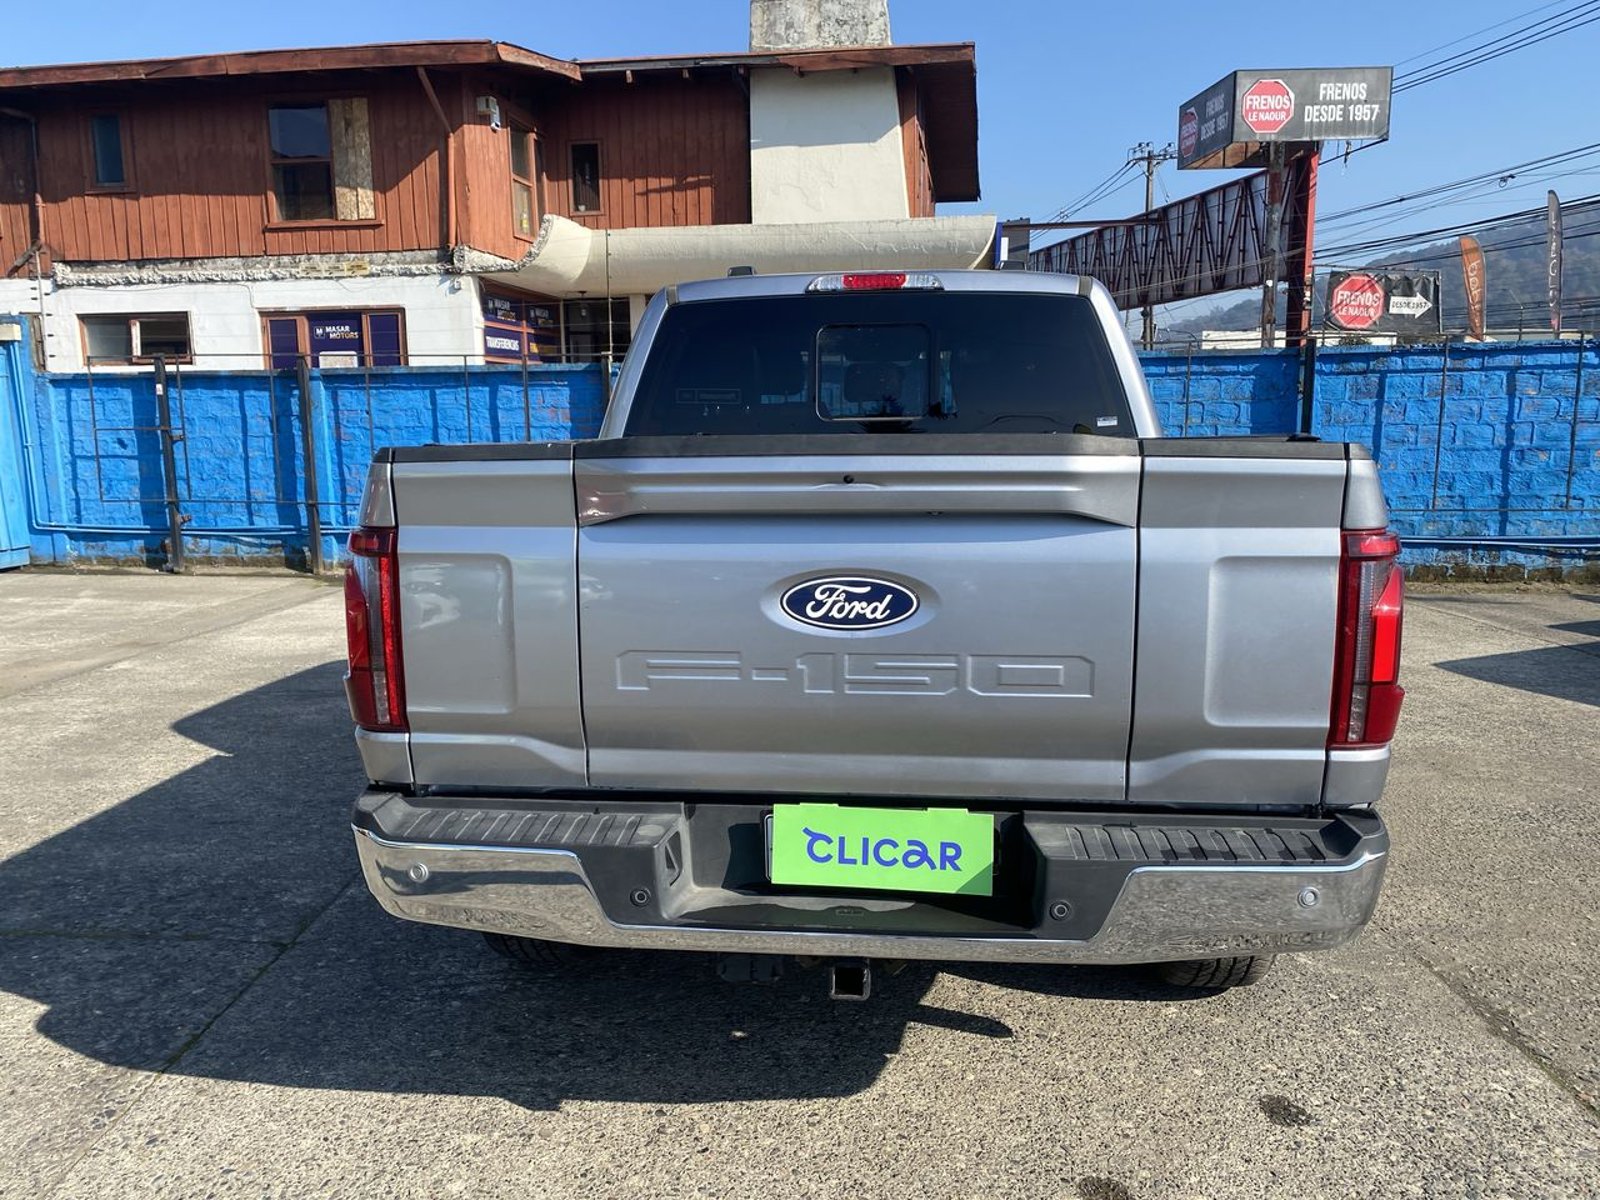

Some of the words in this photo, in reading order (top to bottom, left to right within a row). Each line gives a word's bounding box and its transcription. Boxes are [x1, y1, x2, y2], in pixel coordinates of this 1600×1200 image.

[1319, 82, 1368, 101] FRENOS
[1246, 95, 1291, 110] FRENOS
[1248, 111, 1258, 121] LE
[1258, 111, 1287, 121] NAOUR
[1304, 104, 1345, 122] DESDE
[1348, 104, 1380, 121] 1957
[1336, 290, 1380, 306] FRENOS
[1391, 301, 1411, 309] DESDE
[1338, 306, 1347, 315] LE
[329, 331, 359, 340] MOTORS
[805, 584, 894, 620] Ford
[616, 650, 1095, 699] F-150
